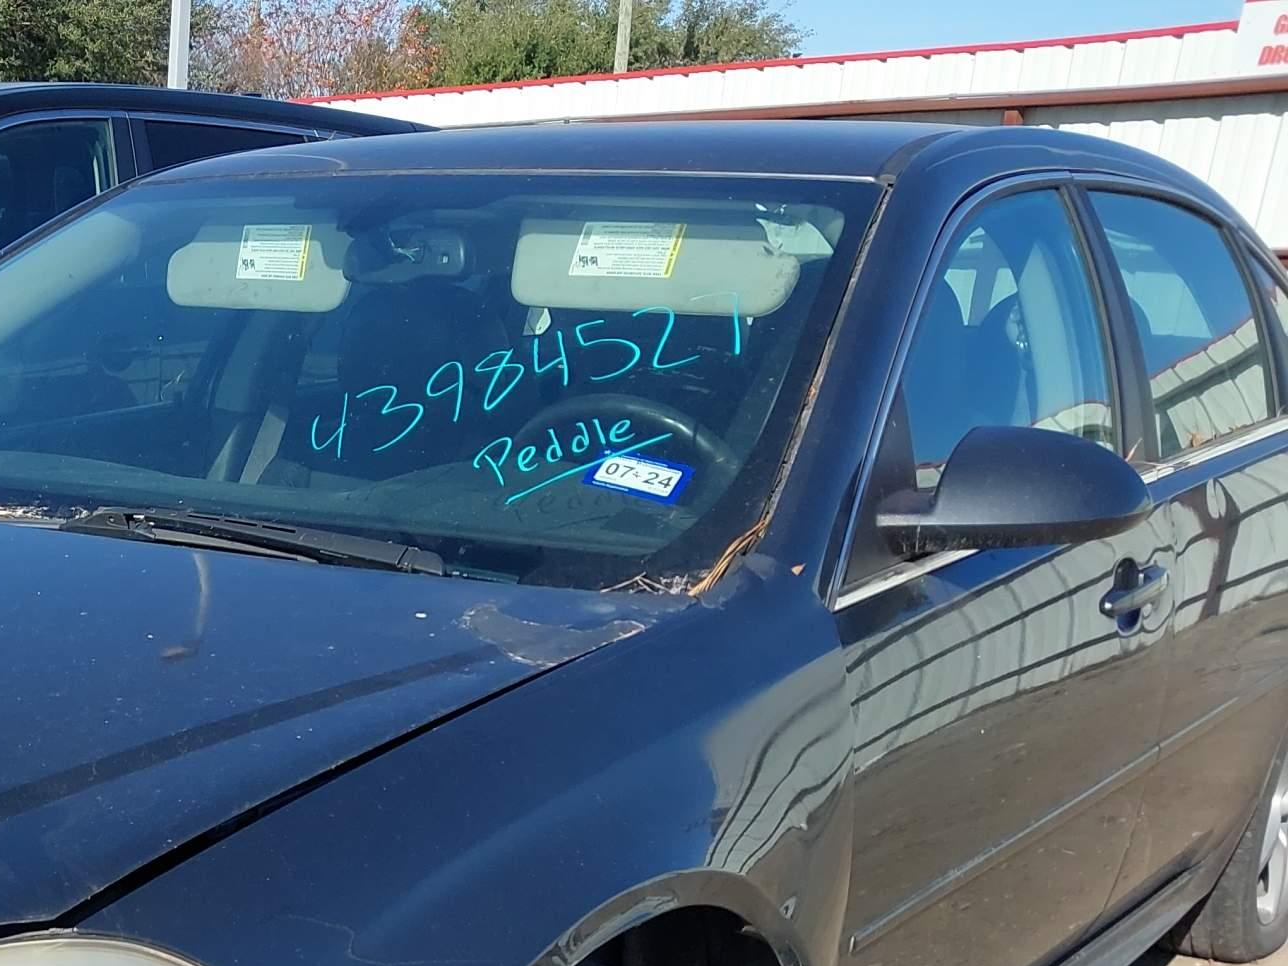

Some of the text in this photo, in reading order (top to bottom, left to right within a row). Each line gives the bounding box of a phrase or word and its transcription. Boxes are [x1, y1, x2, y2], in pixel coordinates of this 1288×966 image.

[311, 291, 741, 459] 43984527
[473, 416, 636, 487] Peddle
[604, 463, 634, 478] 07
[642, 471, 674, 489] 24
